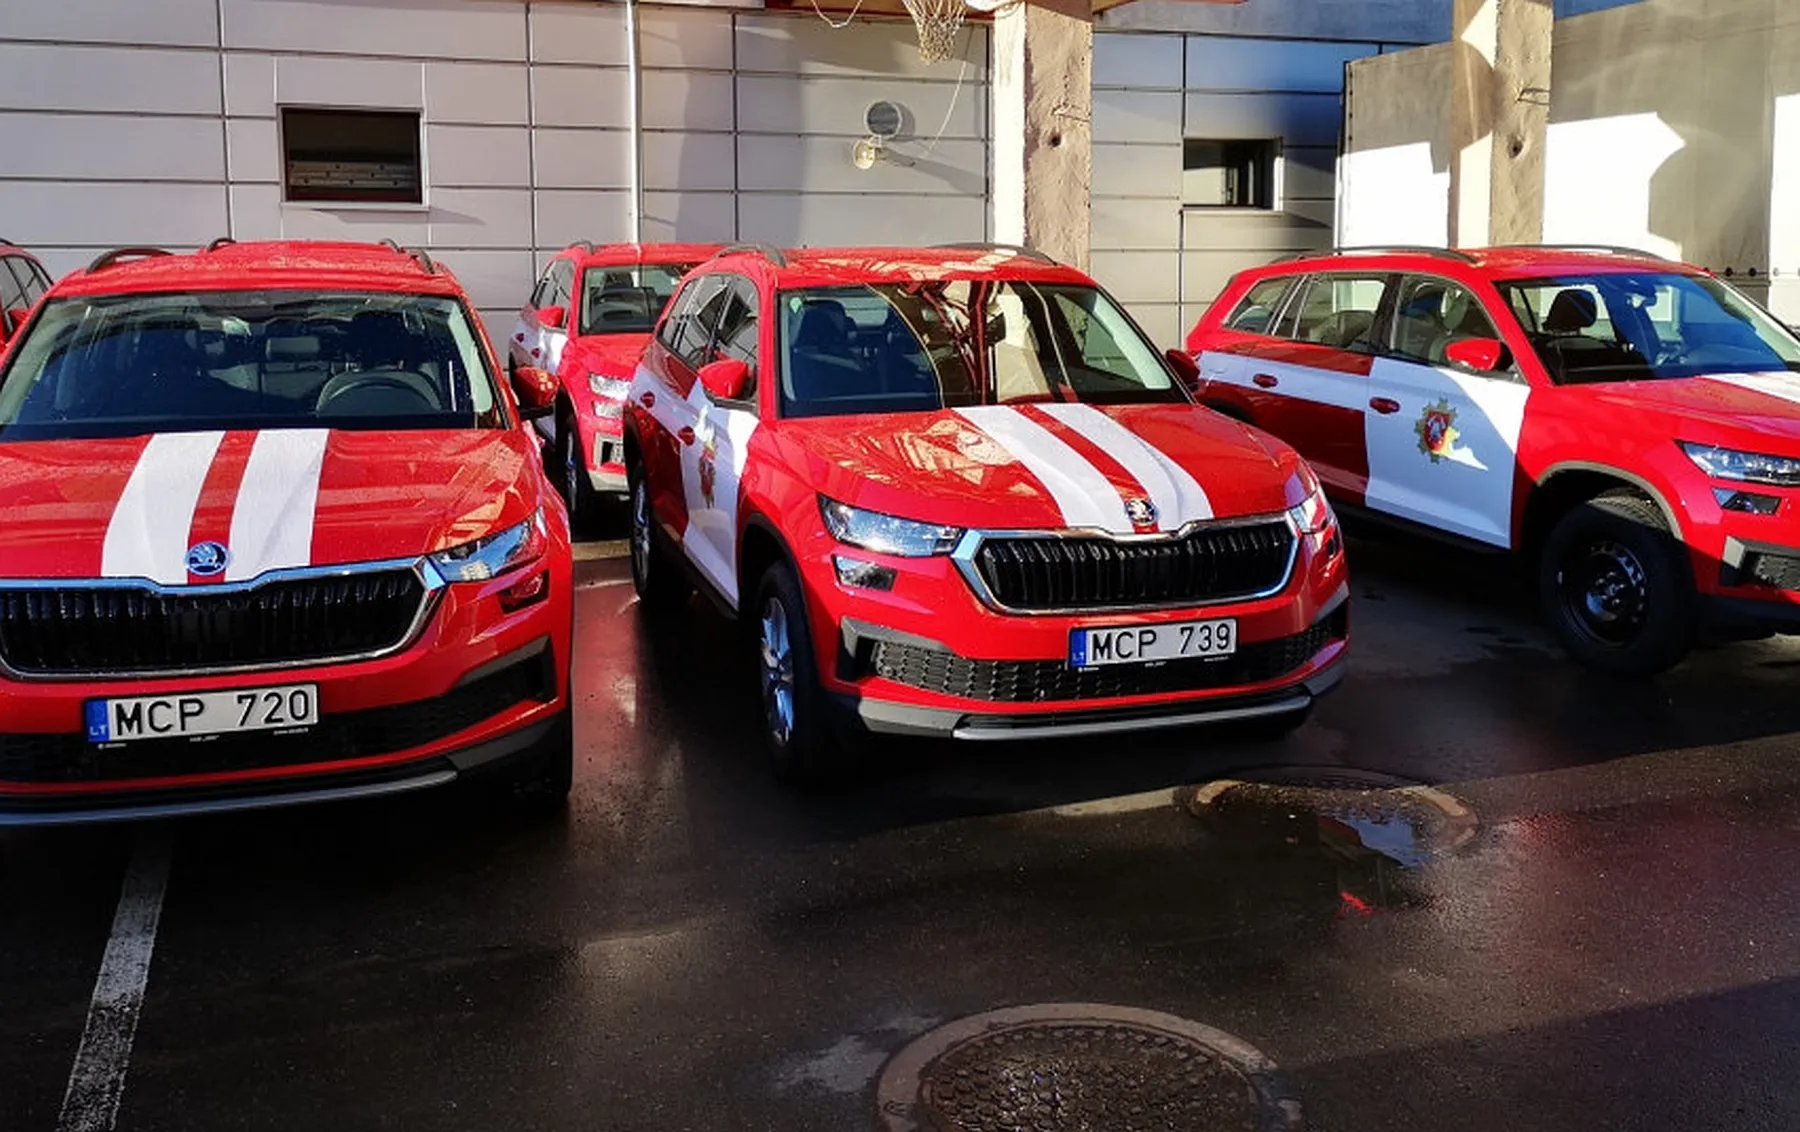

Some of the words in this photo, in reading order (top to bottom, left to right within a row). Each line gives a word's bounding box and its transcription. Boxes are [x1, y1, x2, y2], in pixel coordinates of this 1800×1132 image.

[1092, 629, 1157, 661] MCP
[1180, 623, 1230, 654] 739
[89, 726, 107, 736] LT
[115, 698, 205, 736] MCP
[236, 690, 309, 727] 720
